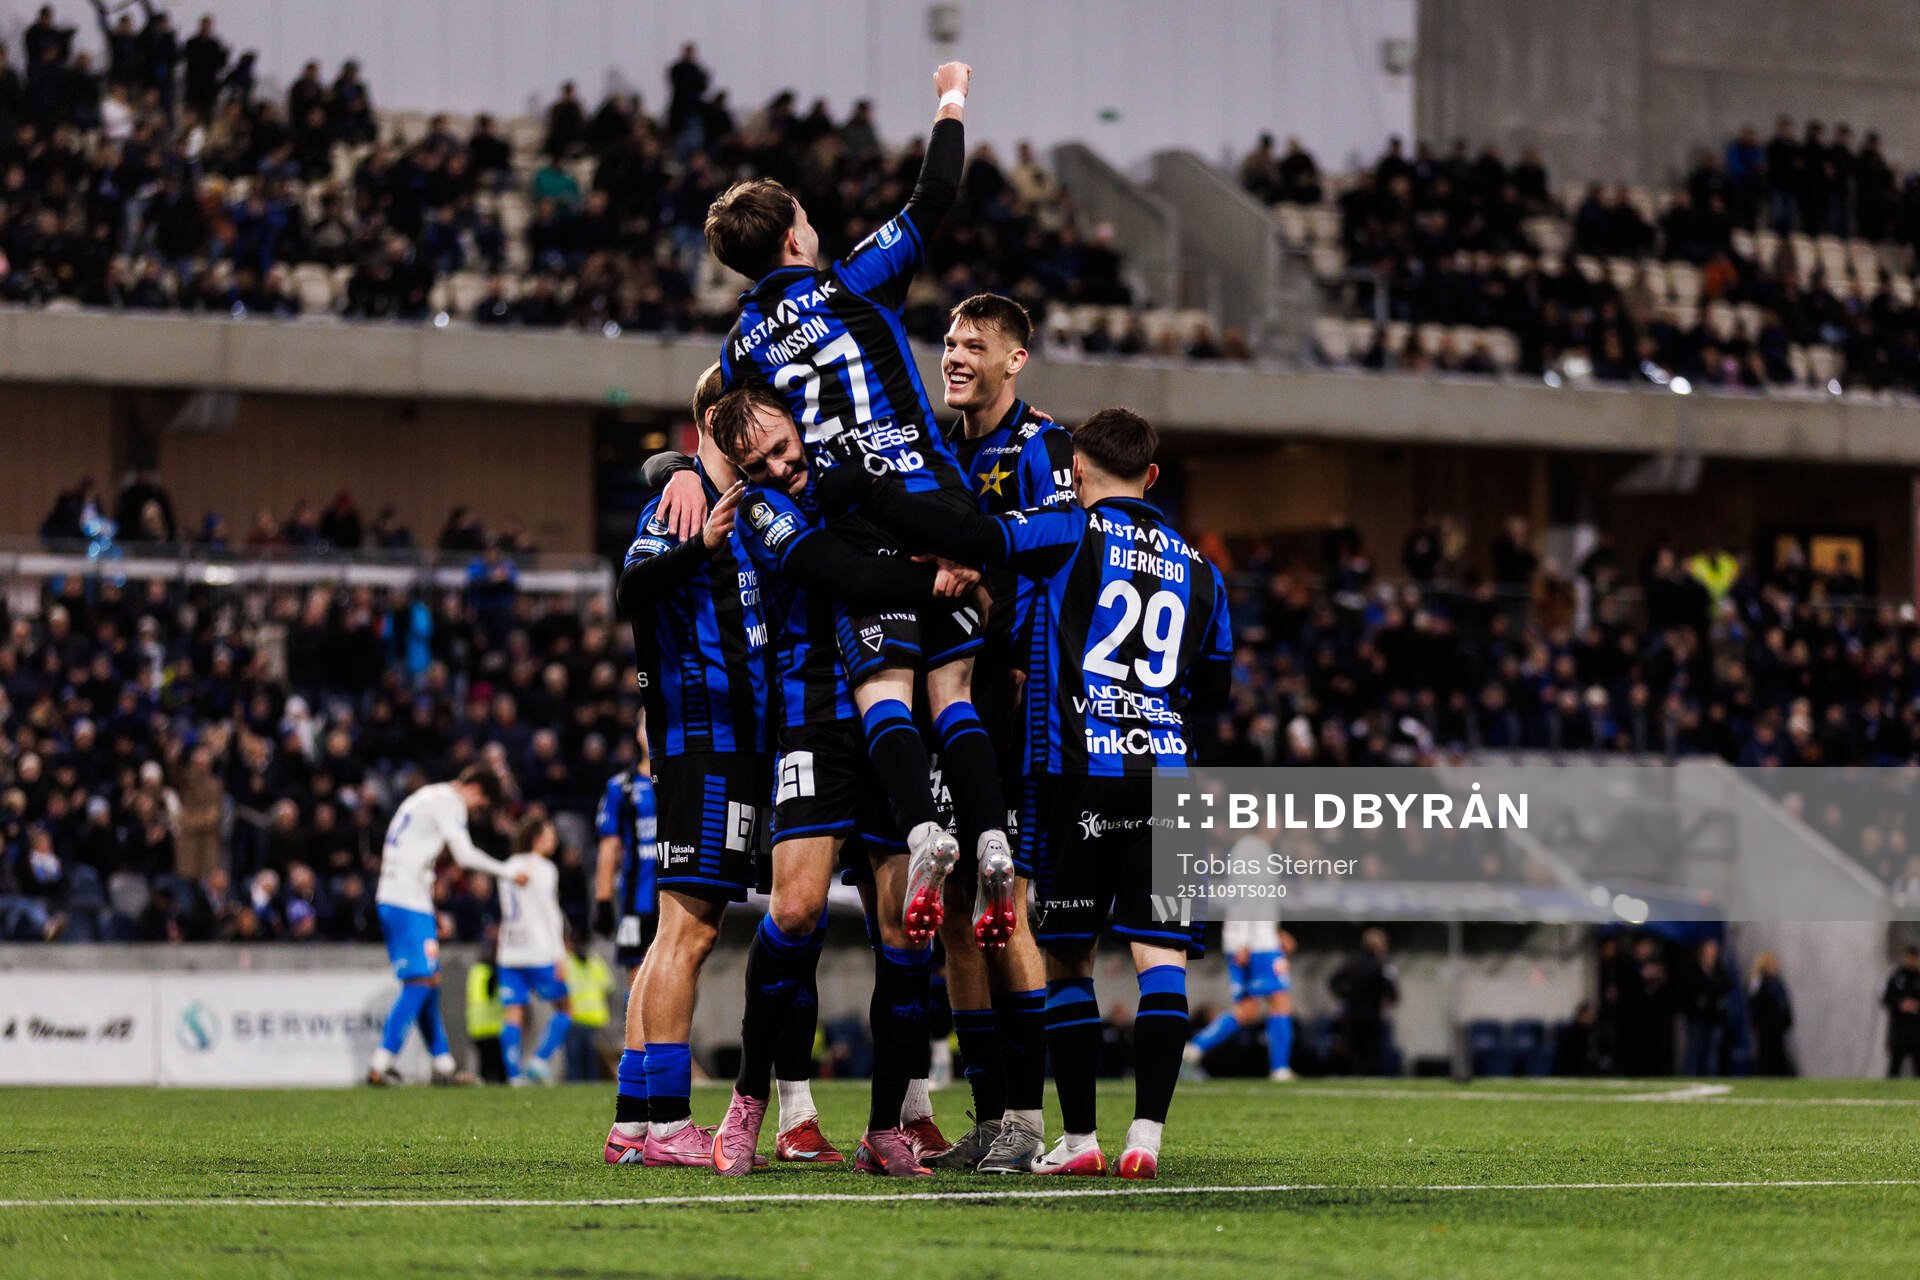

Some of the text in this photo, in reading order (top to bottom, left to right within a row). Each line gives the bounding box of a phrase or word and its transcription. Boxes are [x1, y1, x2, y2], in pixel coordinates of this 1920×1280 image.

[797, 280, 837, 309] TAK
[774, 332, 872, 443] 27
[1043, 490, 1077, 506] unisp
[764, 515, 794, 547] UNIBET
[1089, 513, 1203, 564] ÅRSTA TAK
[1109, 545, 1184, 584] BJERKEBO
[859, 624, 882, 637] TEAM
[1082, 579, 1186, 688] 29
[1088, 684, 1165, 712] NORDIC
[1085, 728, 1187, 755] inkClub
[670, 845, 695, 854] Vaksala
[670, 855, 689, 864] måleri
